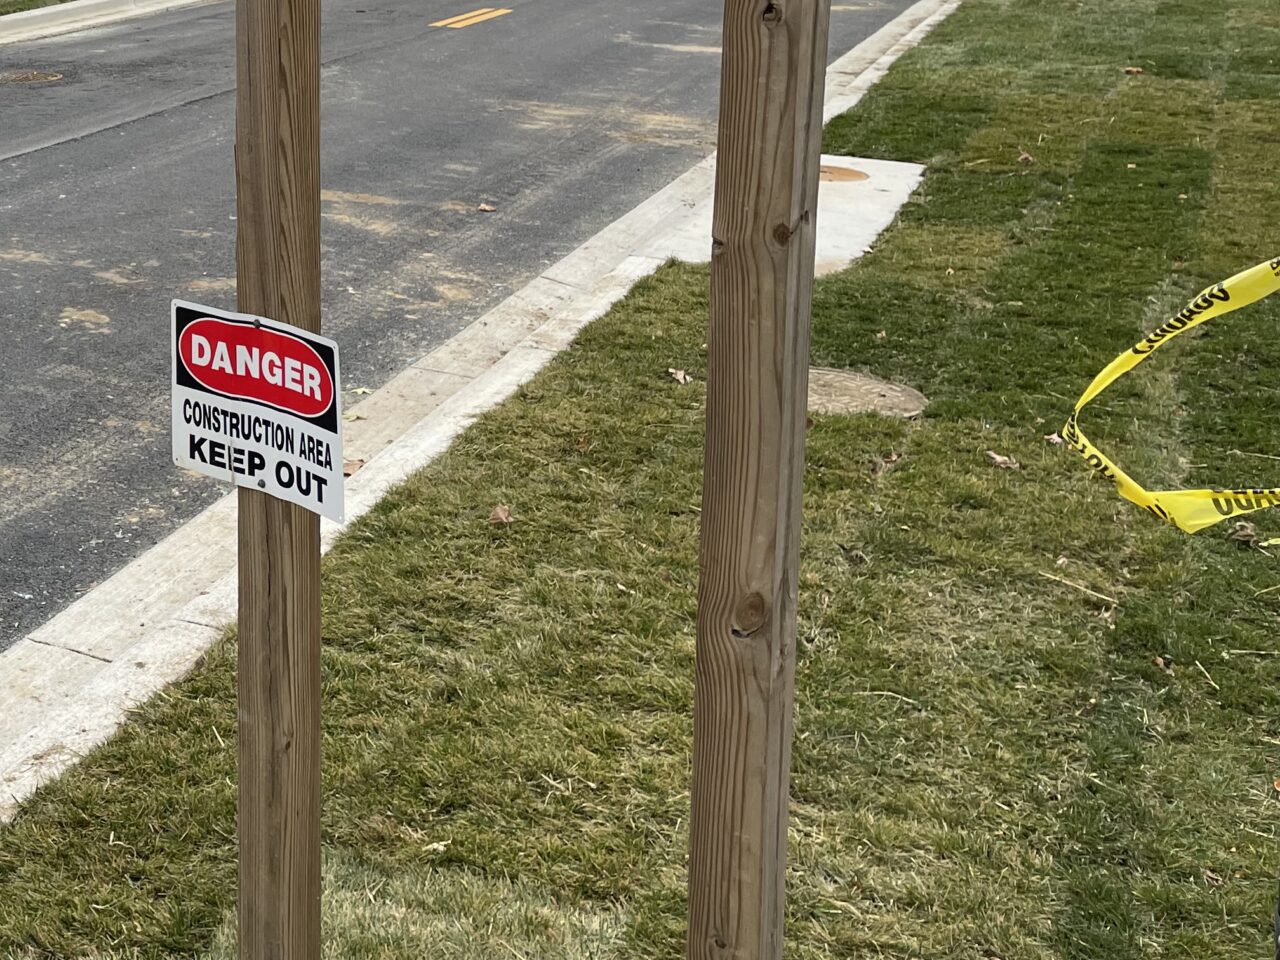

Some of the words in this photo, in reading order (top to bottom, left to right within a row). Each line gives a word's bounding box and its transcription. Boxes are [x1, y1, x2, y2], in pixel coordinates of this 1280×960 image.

[191, 333, 322, 401] DANGER
[183, 398, 295, 455] CONSTRUCTION
[299, 432, 333, 472] AREA
[189, 433, 266, 477] KEEP
[275, 460, 328, 504] OUT
